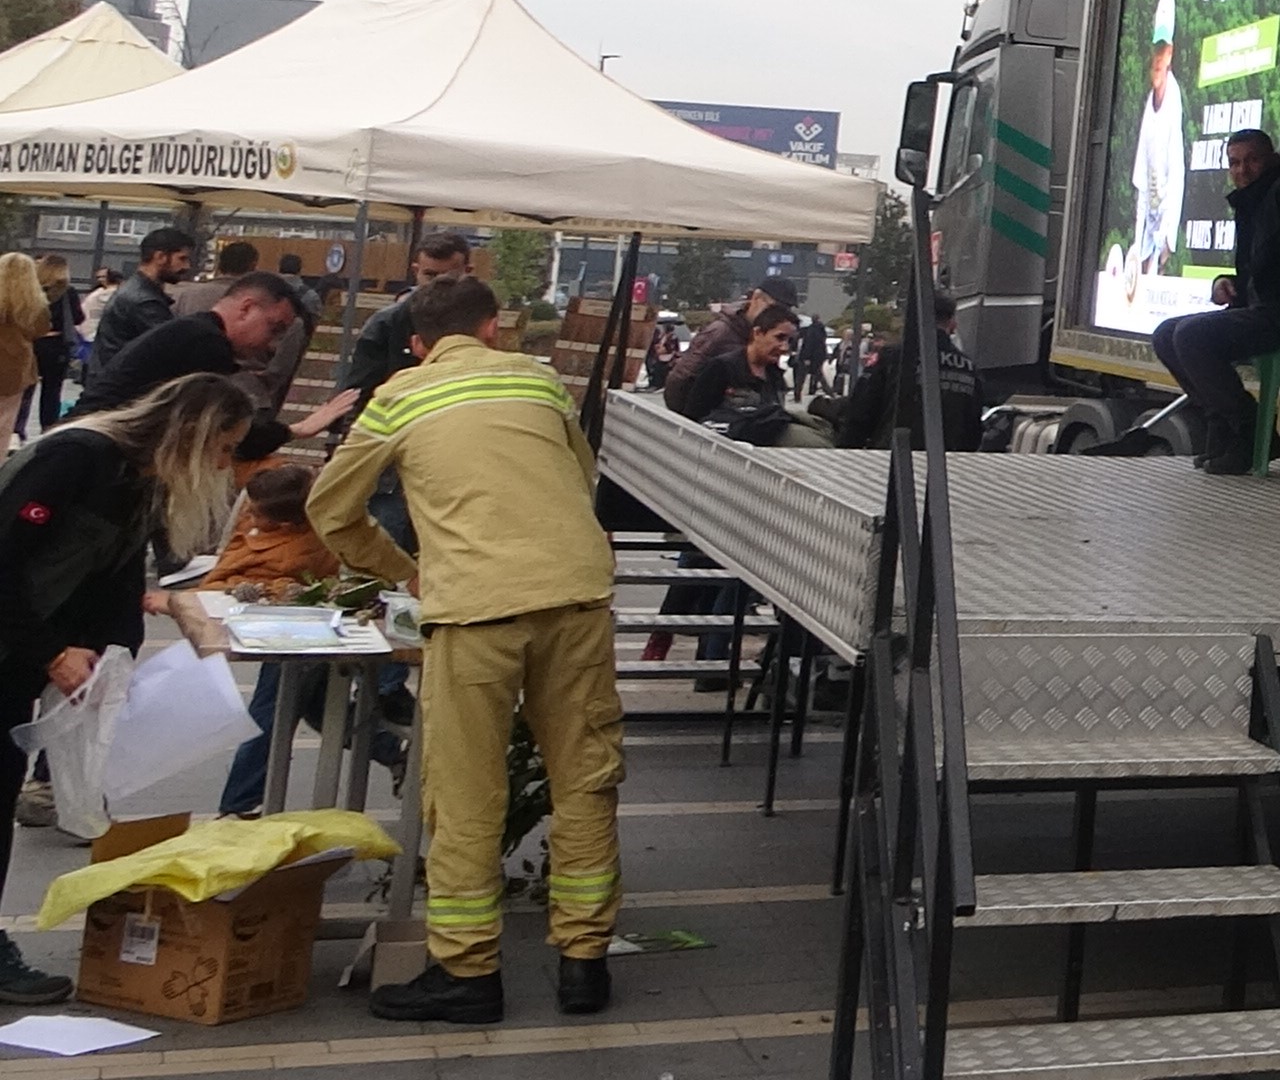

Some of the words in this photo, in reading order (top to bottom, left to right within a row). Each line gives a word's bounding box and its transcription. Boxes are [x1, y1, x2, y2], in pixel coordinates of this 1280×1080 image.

[789, 141, 825, 152] VAKIF
[17, 142, 79, 173] ORMAN
[84, 137, 144, 175] BÖLGE
[150, 136, 272, 180] MÜDÜRLÜĞÜ
[940, 351, 974, 372] KUT
